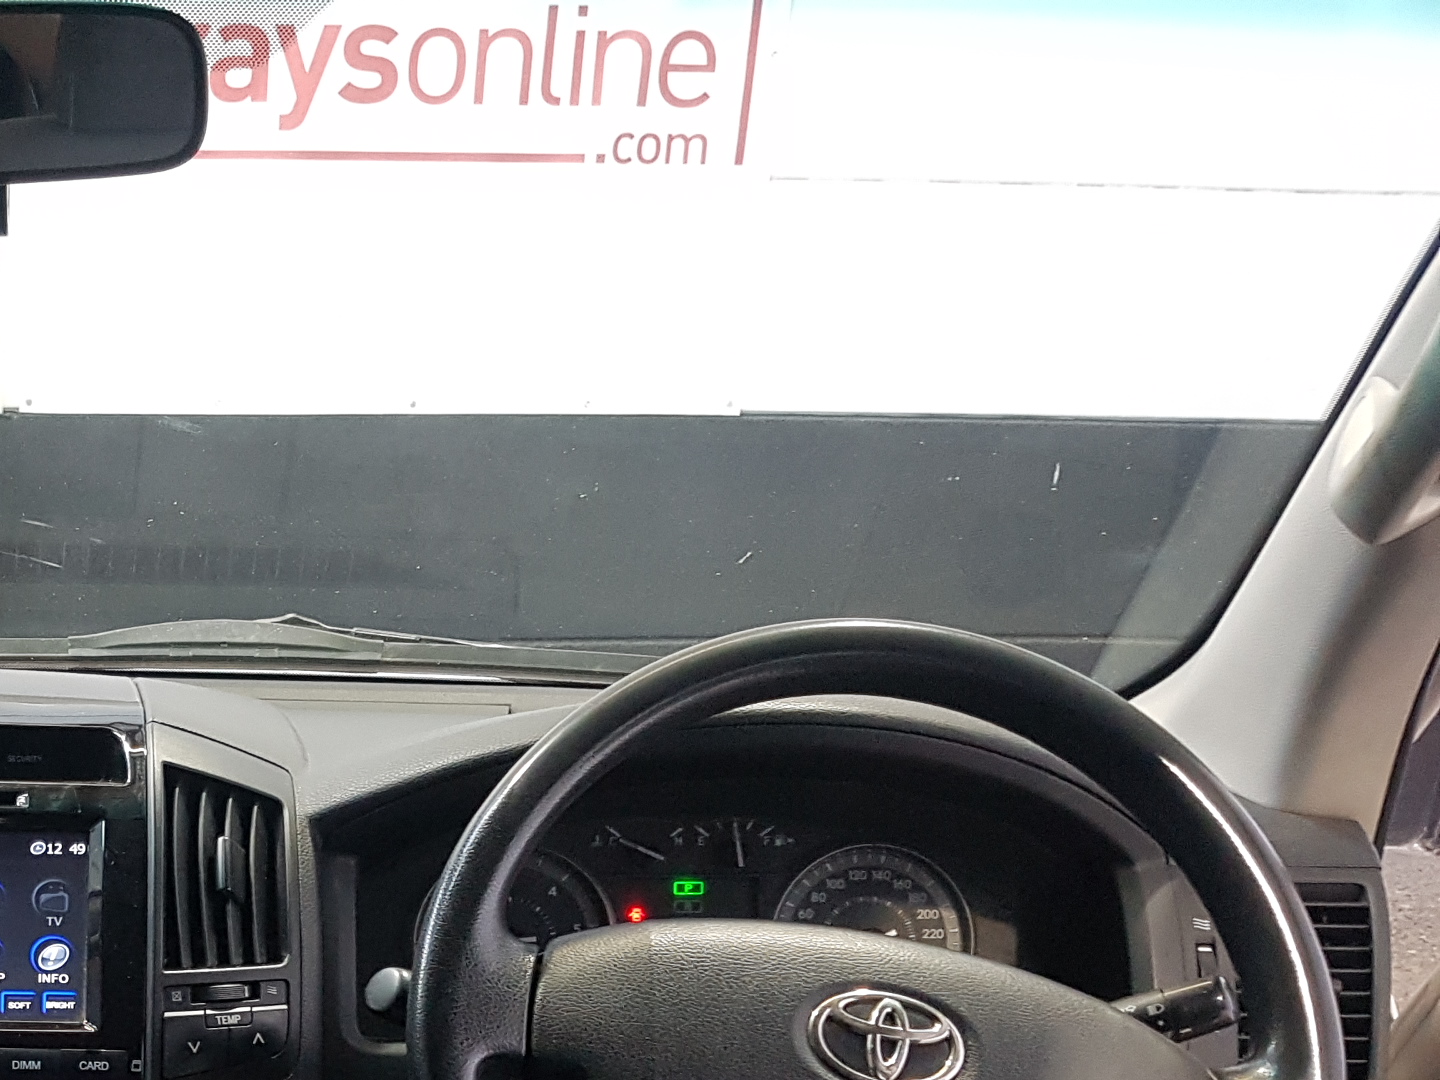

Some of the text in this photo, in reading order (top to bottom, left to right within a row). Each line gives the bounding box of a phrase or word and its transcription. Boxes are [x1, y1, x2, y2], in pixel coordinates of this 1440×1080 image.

[596, 132, 708, 165] .com
[7, 754, 42, 763] SECURITY
[46, 843, 86, 856] 12 49
[547, 886, 558, 897] 4
[916, 909, 939, 920] 200
[46, 916, 62, 927] TV
[922, 928, 944, 939] 220
[38, 972, 69, 983] INFO
[8, 1001, 31, 1010] SOFT
[46, 1000, 75, 1010] BRIGHT
[215, 1015, 241, 1025] TEMP
[12, 1060, 41, 1071] DIMM
[79, 1060, 109, 1071] CARD
